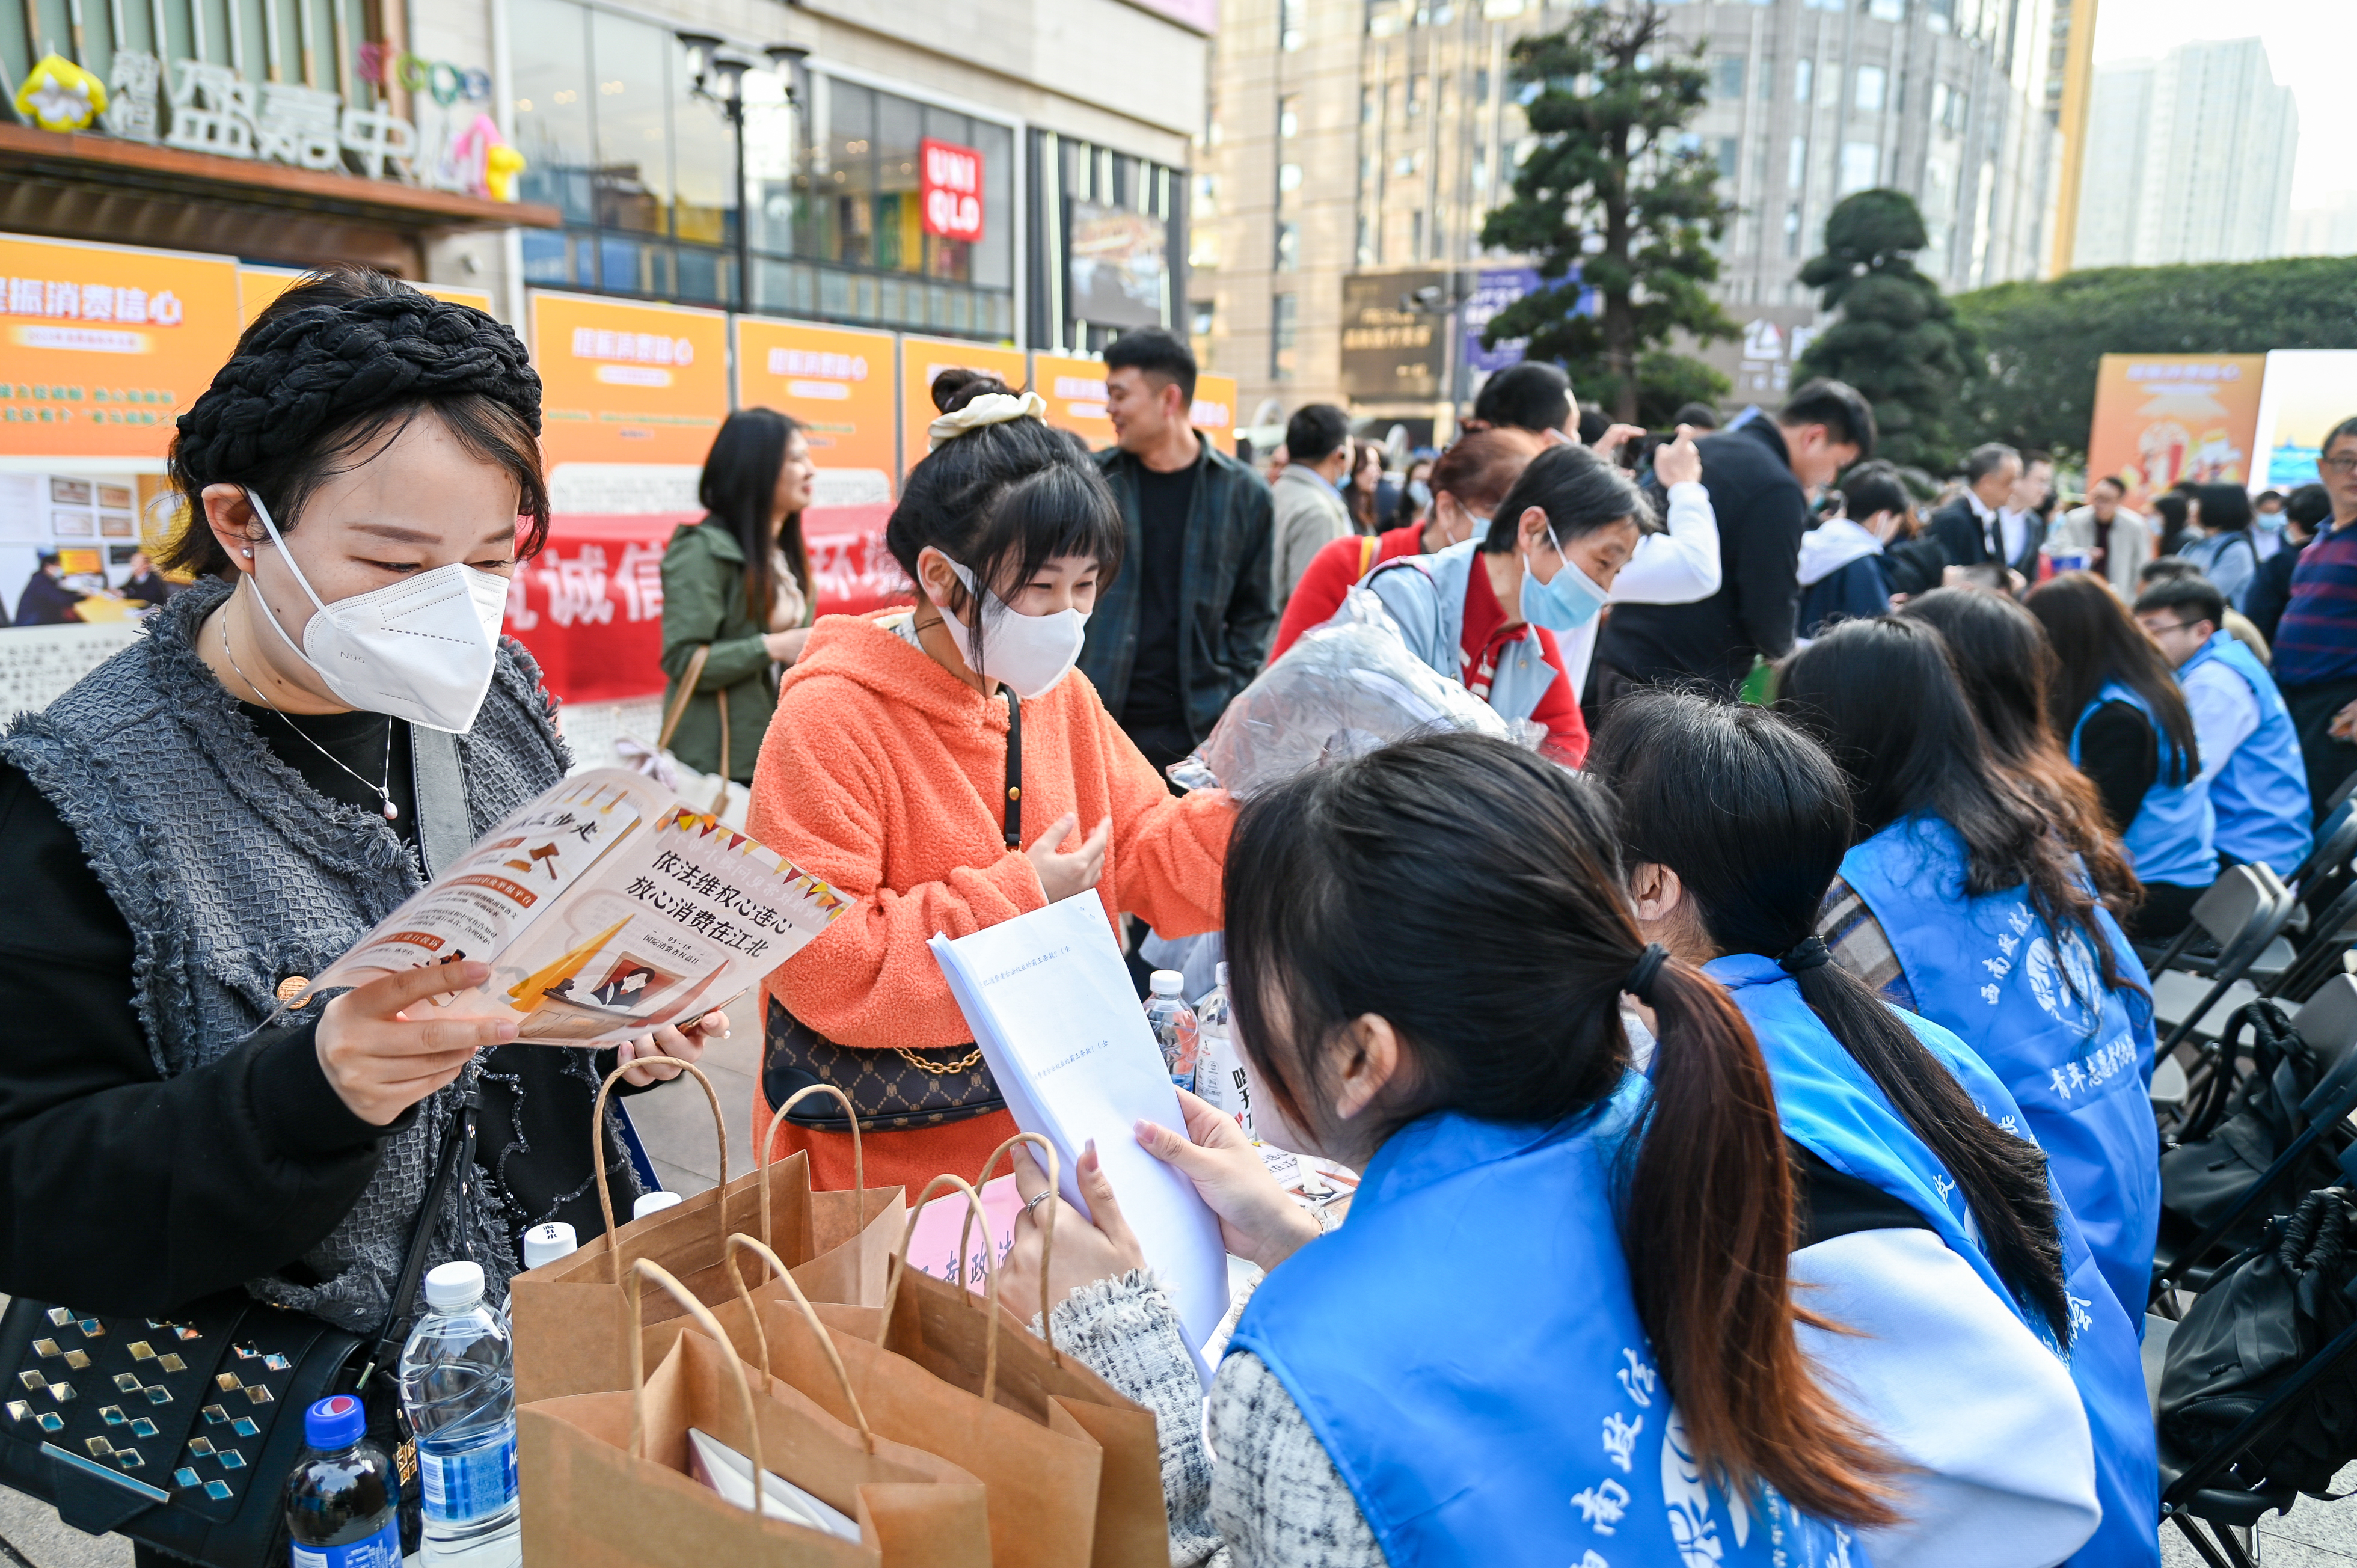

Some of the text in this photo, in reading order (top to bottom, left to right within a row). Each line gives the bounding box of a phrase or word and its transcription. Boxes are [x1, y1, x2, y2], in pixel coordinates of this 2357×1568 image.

[927, 147, 976, 193] UNI
[927, 189, 980, 234] QLO
[340, 651, 365, 664] N95
[652, 850, 794, 935] 依法维权心连心
[625, 876, 770, 958] 放心消费在江北
[643, 934, 699, 964] 国际消费者权益日
[920, 1230, 1012, 1285] 南政法
